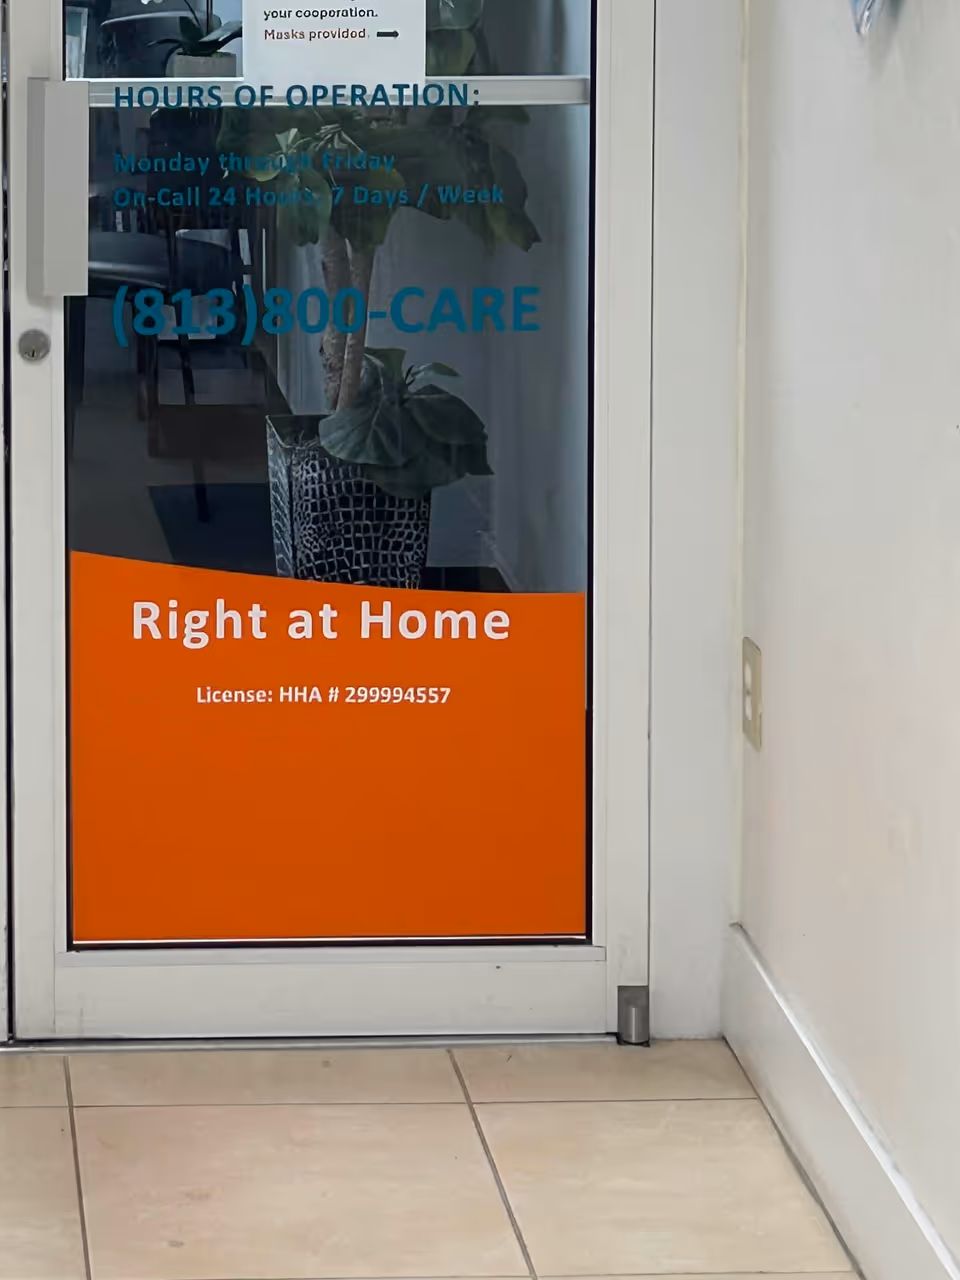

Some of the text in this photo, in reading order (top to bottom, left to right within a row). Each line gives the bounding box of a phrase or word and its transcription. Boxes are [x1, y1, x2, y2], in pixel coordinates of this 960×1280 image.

[263, 7, 378, 21] your cooperation.
[264, 28, 370, 41] Masks provided.
[113, 82, 480, 110] HOURS OF OPERATION:
[113, 151, 396, 176] Monday through Friday
[113, 186, 200, 209] On-Call
[208, 187, 236, 206] 24
[331, 186, 344, 205] 7
[353, 185, 408, 208] Days
[416, 183, 429, 208] /
[437, 184, 504, 204] Week
[112, 284, 541, 348] (813)800-CARE
[132, 598, 511, 649] Right at Home
[196, 685, 452, 705] License: HHA # 299994557
